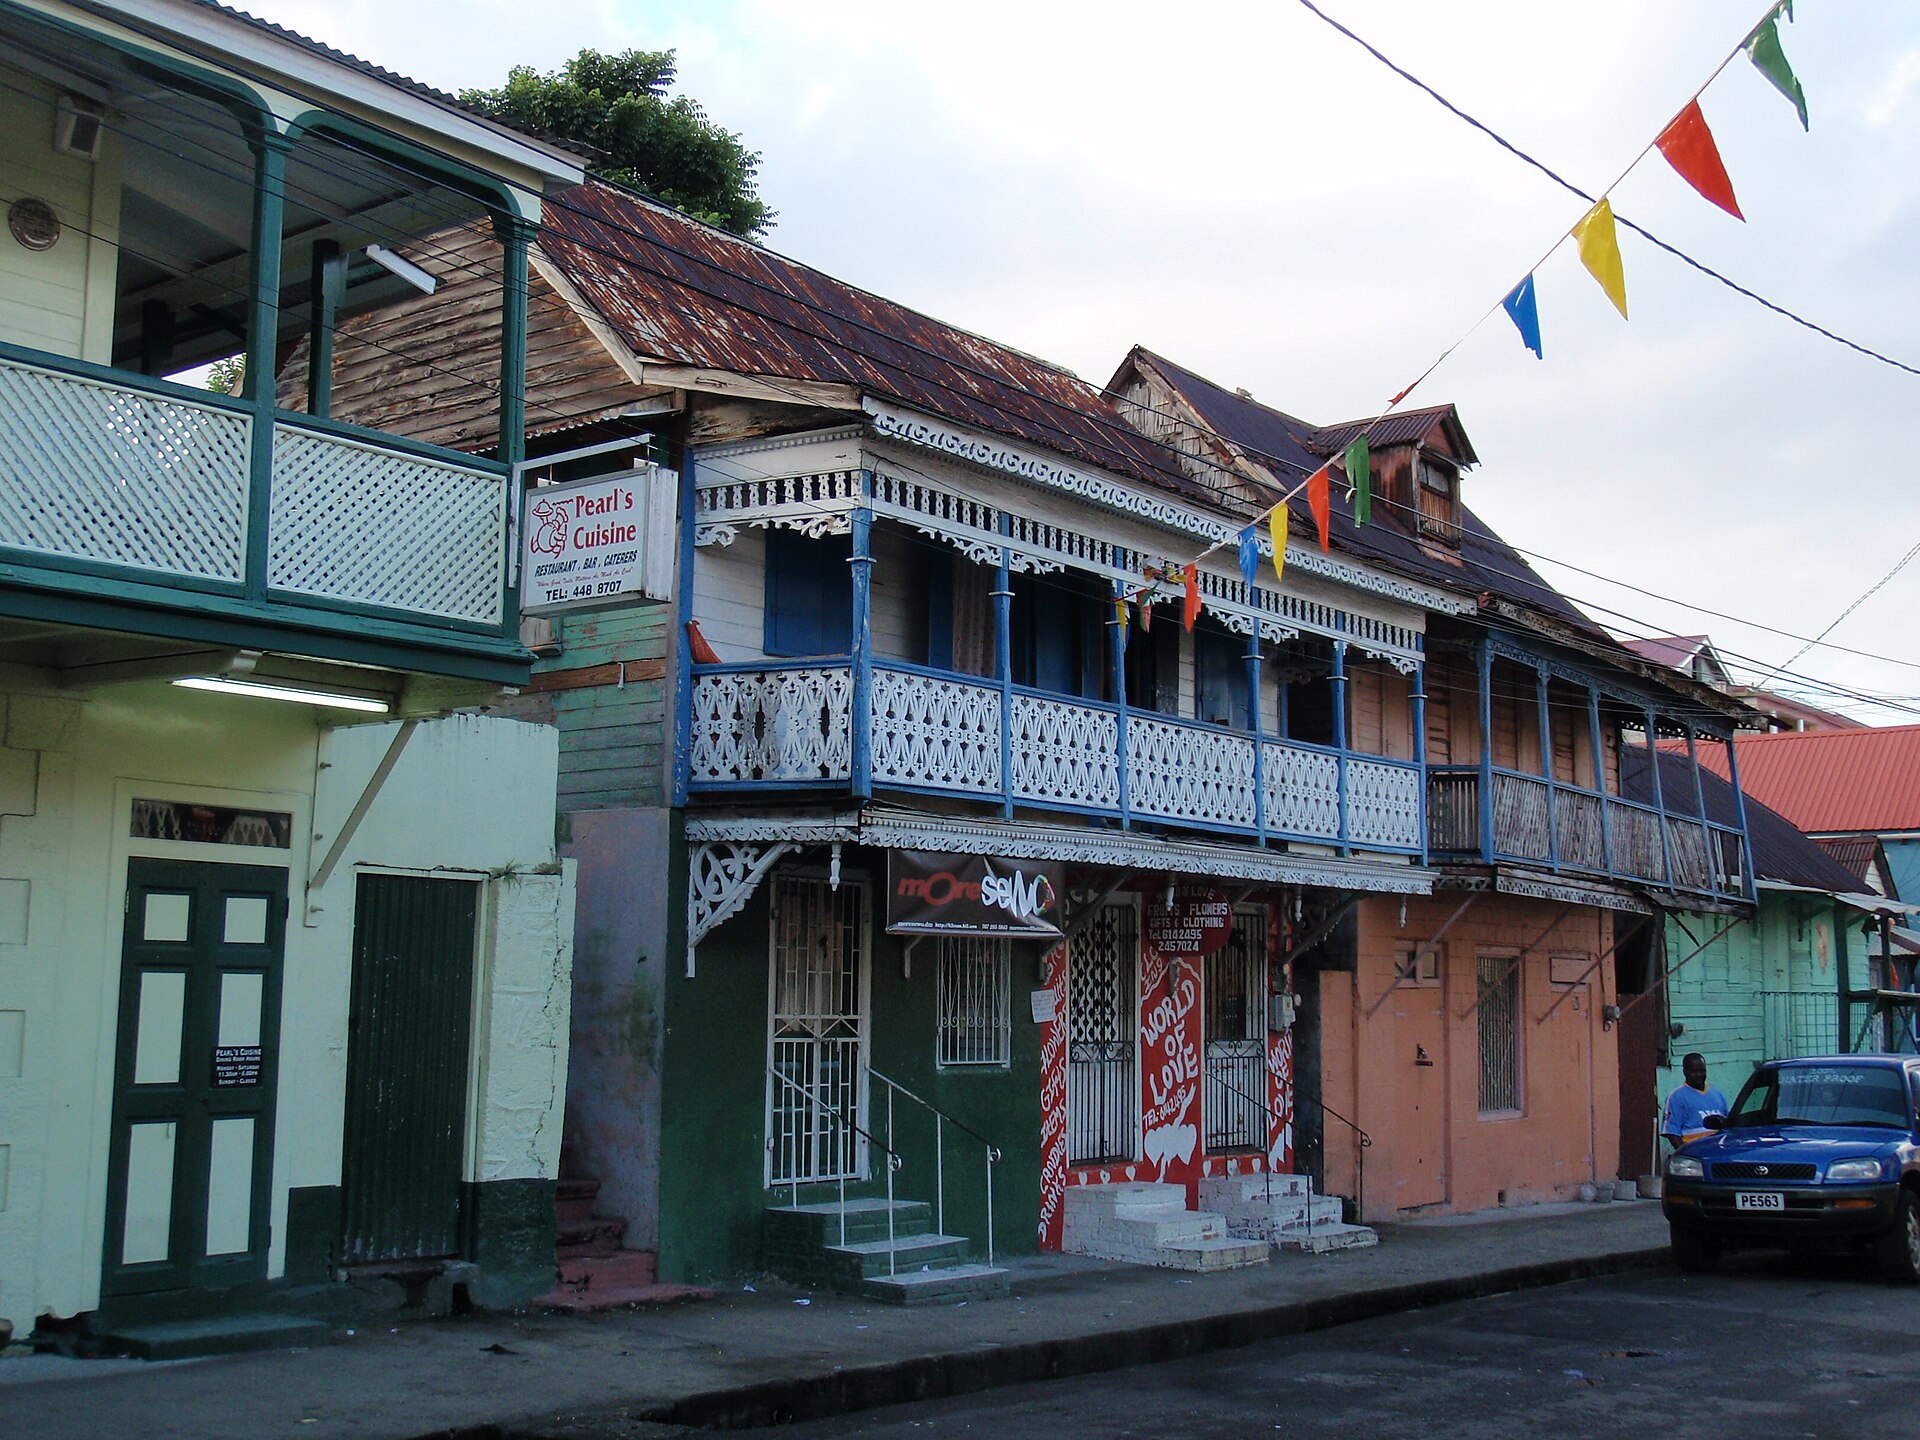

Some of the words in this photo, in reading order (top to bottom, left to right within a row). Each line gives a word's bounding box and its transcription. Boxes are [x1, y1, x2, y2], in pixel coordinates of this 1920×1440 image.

[575, 488, 634, 518] Pearl's
[573, 521, 637, 550] Cuisine
[534, 560, 578, 577] RESTAURANT
[583, 556, 598, 570] BAR
[603, 549, 638, 567] CATERERS
[545, 588, 568, 601] TEL:
[572, 584, 592, 597] 448
[597, 580, 622, 594] 8707
[1183, 917, 1225, 928] CLOTHING
[1189, 902, 1228, 916] FLOWERS
[1158, 940, 1200, 952] 2457024
[1162, 928, 1202, 940] 6142495
[1141, 979, 1195, 1047] WORLD
[1164, 1019, 1186, 1057] OF
[1149, 1042, 1199, 1106] LOVE
[1037, 1166, 1067, 1242] DRINKS
[1741, 1195, 1779, 1208] PE563
